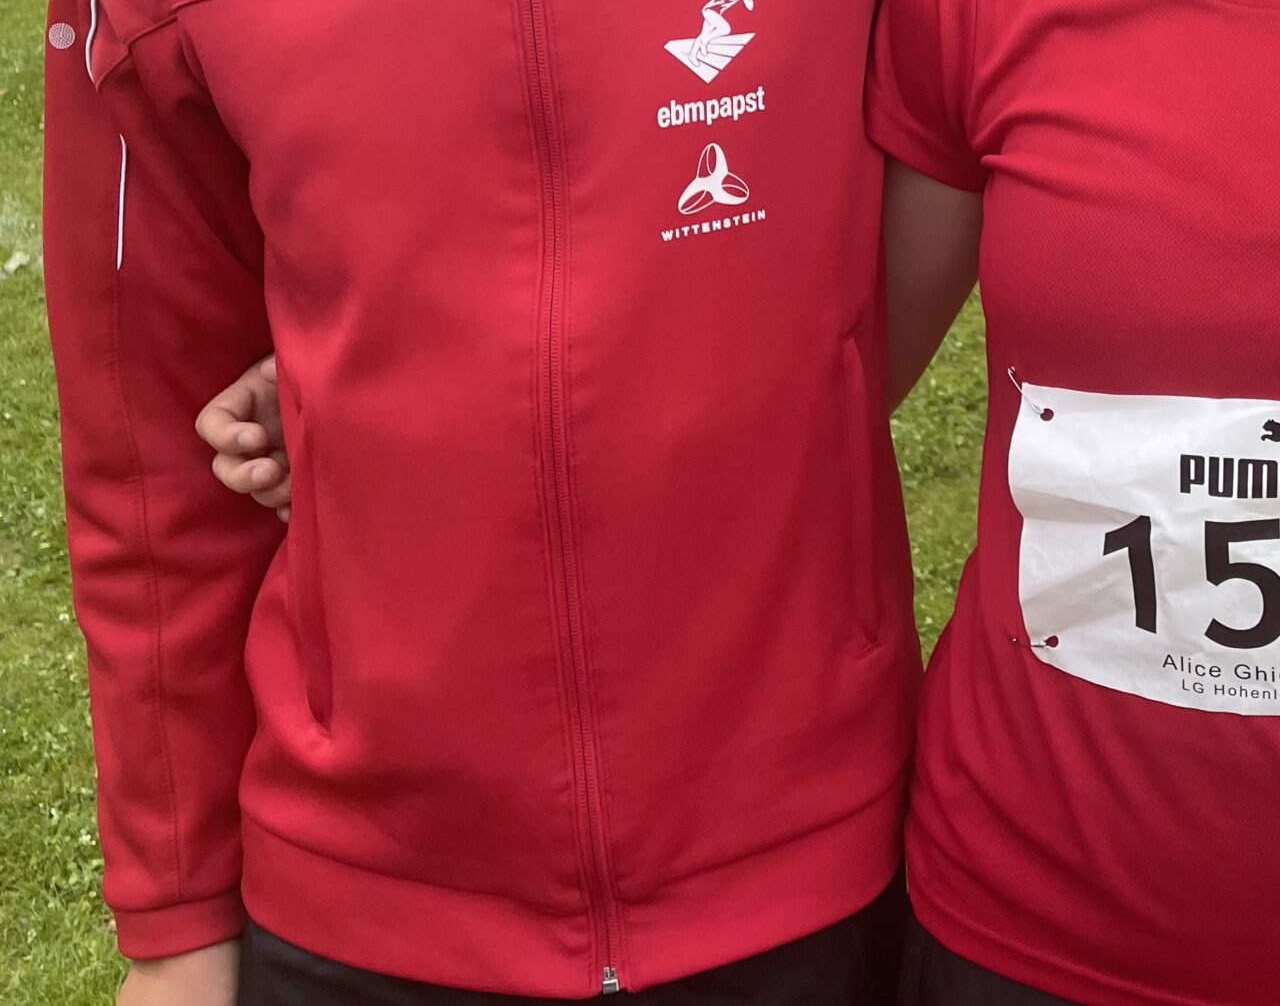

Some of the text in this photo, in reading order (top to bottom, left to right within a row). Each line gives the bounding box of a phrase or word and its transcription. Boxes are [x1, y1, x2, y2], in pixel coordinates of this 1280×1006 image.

[656, 85, 766, 129] ebmpapst
[660, 209, 766, 242] WITTENSTEIN
[1162, 654, 1222, 678] Alice
[1182, 679, 1205, 694] LG
